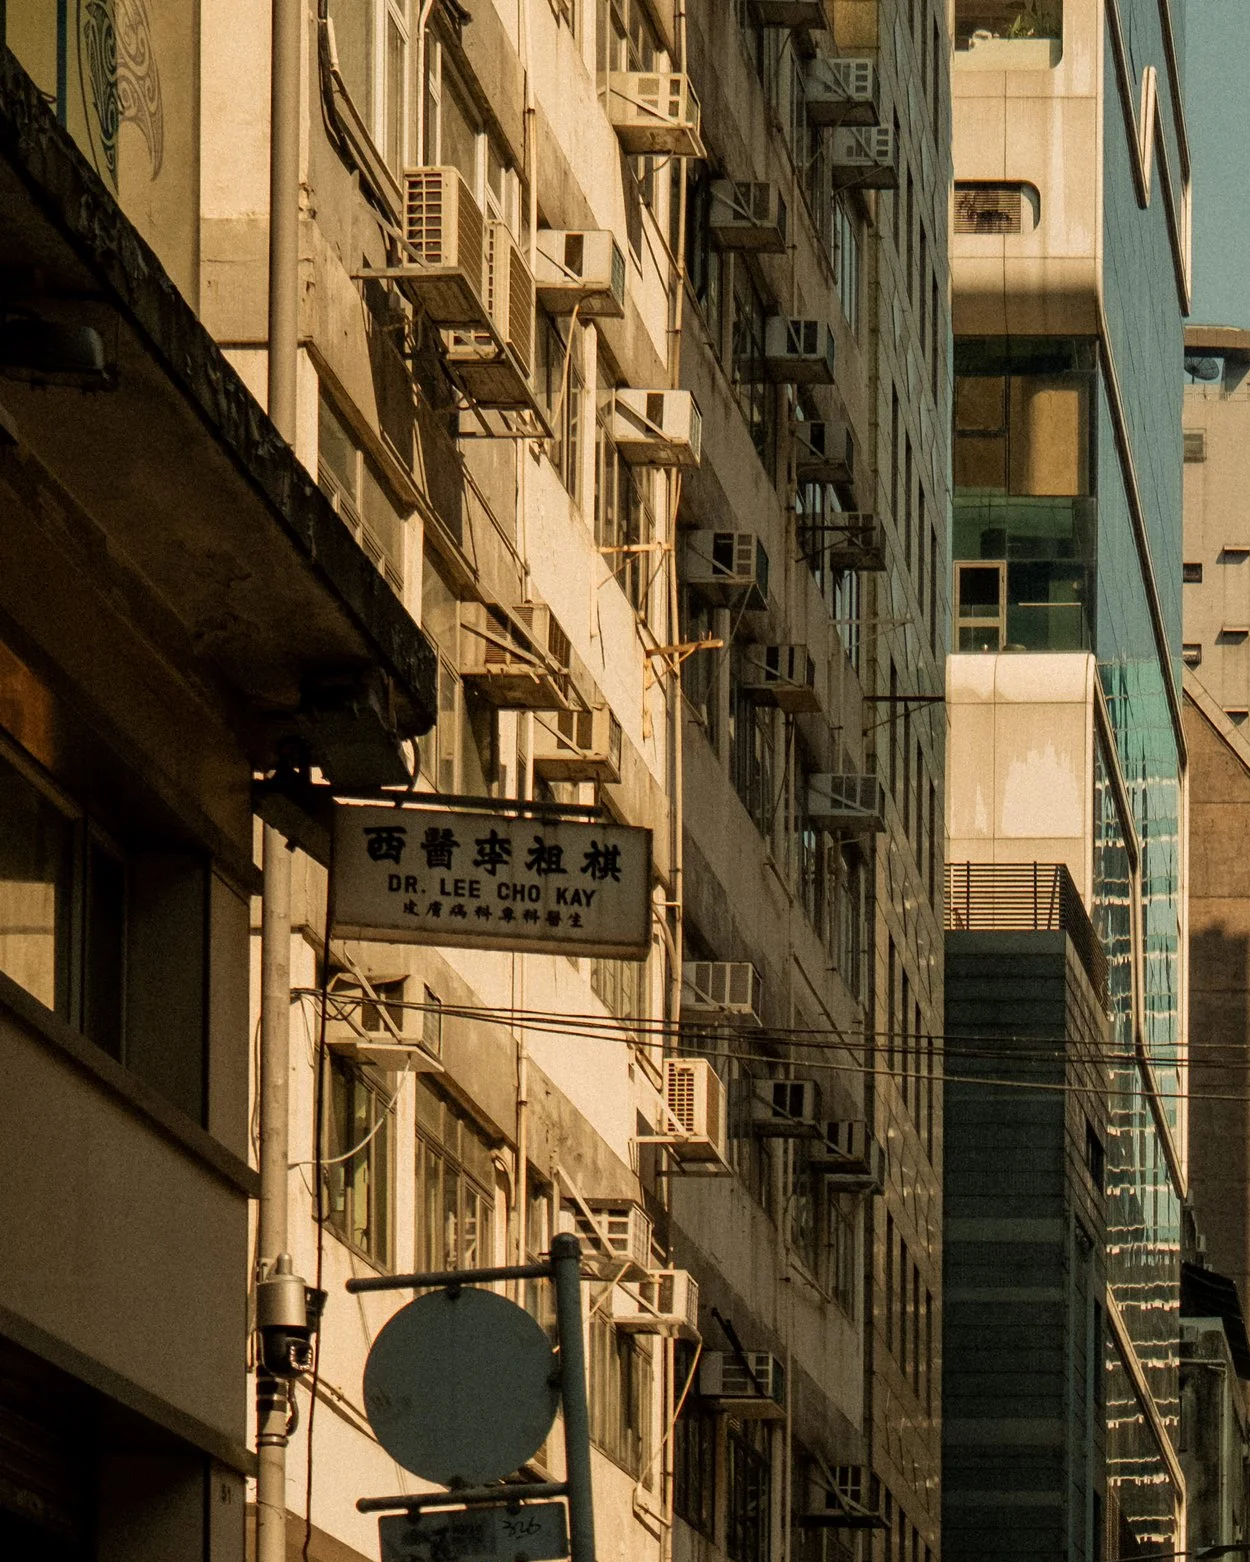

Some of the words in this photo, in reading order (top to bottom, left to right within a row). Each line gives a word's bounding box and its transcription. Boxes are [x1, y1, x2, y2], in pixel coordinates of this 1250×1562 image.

[388, 873, 427, 895] DR.
[440, 878, 482, 899] LEE
[497, 882, 541, 903] CHO
[556, 886, 596, 908] KAY
